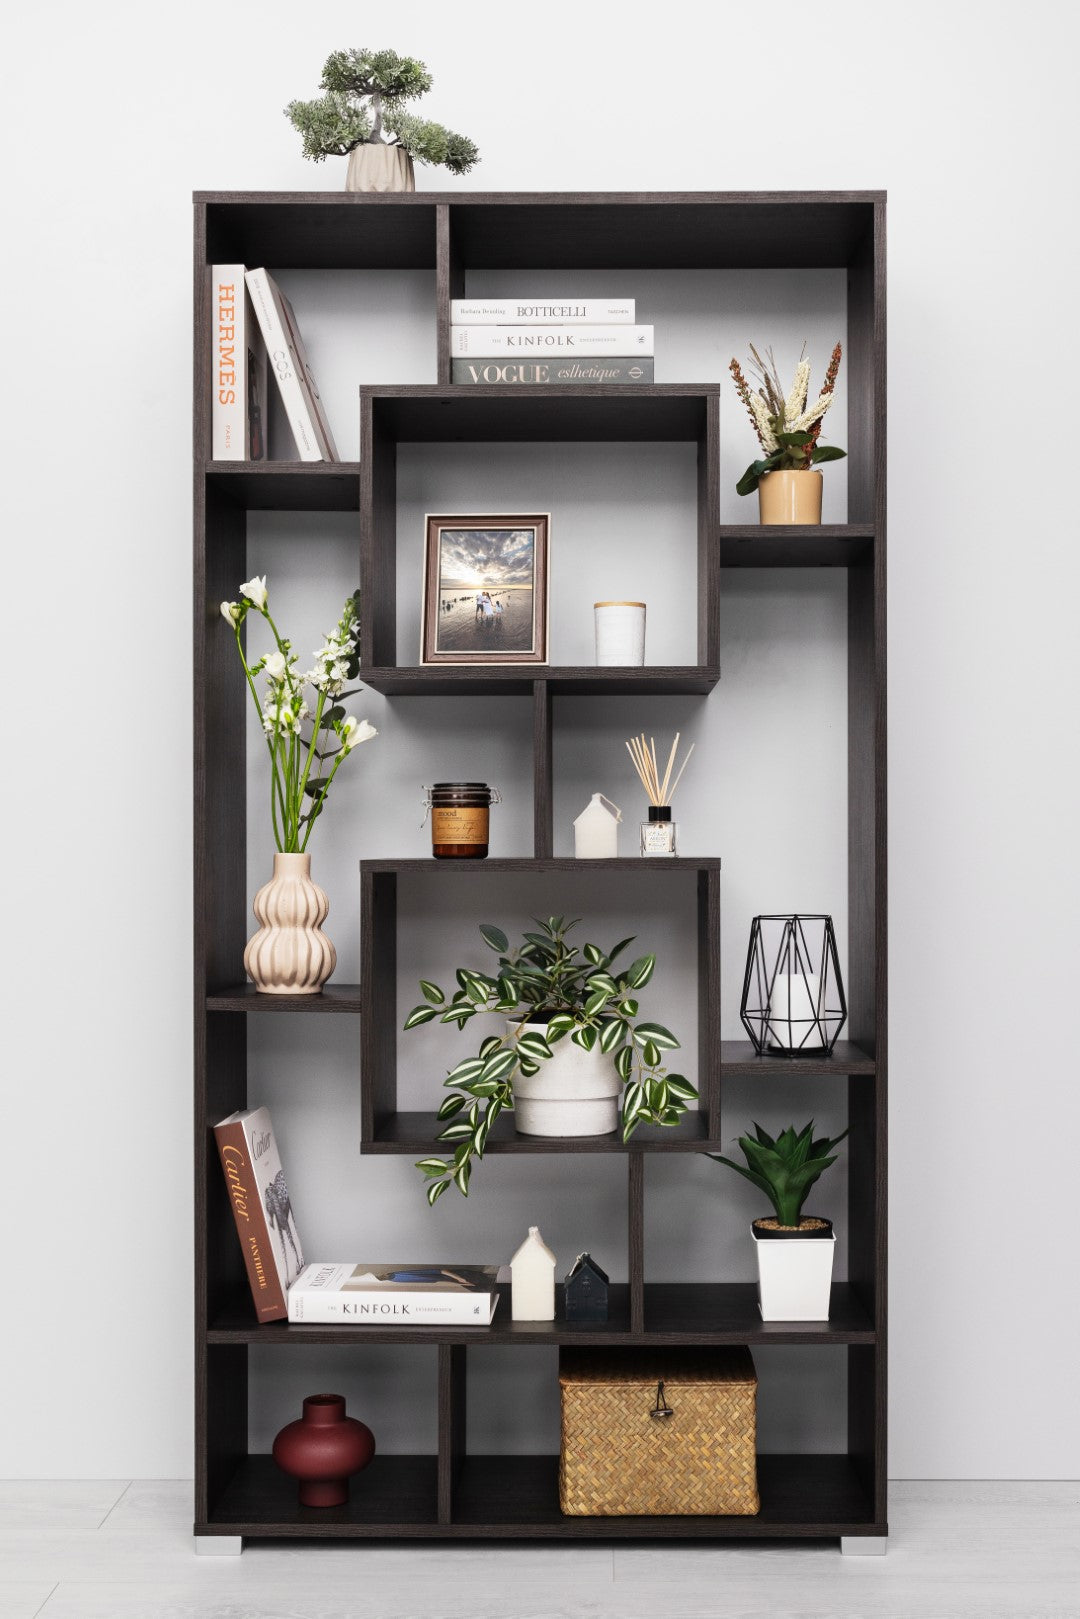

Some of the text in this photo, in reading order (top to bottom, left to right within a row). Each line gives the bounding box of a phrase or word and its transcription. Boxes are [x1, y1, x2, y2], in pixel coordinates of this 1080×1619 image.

[516, 306, 587, 317] BOTTICELLI
[506, 335, 575, 346] KINFOLK
[272, 351, 292, 382] COS
[468, 364, 550, 384] VOGUE
[222, 1145, 250, 1222] Cartier
[342, 1303, 410, 1315] KINFOLK
